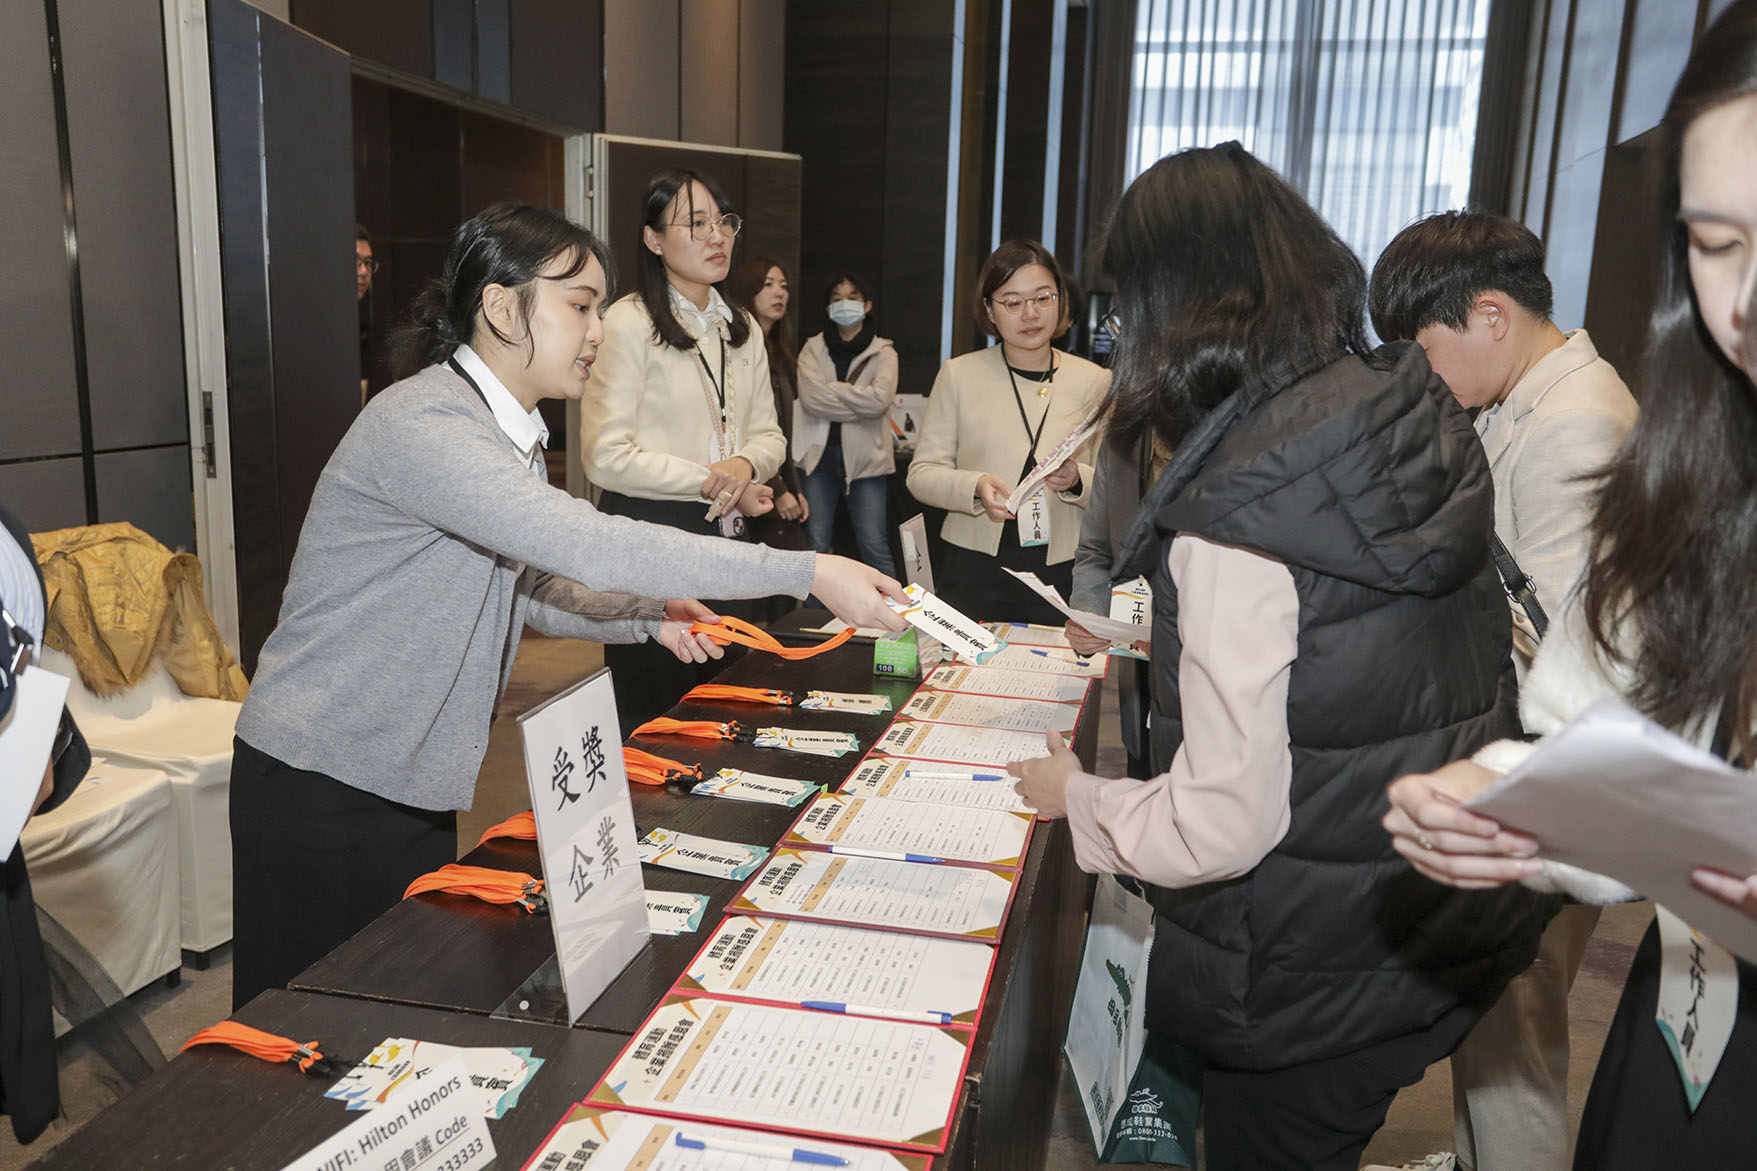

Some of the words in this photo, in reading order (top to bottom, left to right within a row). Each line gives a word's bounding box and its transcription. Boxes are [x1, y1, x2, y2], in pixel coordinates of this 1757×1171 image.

[1032, 502, 1041, 540] 工作人員
[552, 725, 606, 811] 受獎
[568, 816, 620, 903] 企業
[358, 1113, 409, 1155] Hilton
[408, 1076, 461, 1120] Honors
[435, 1116, 468, 1145] Code
